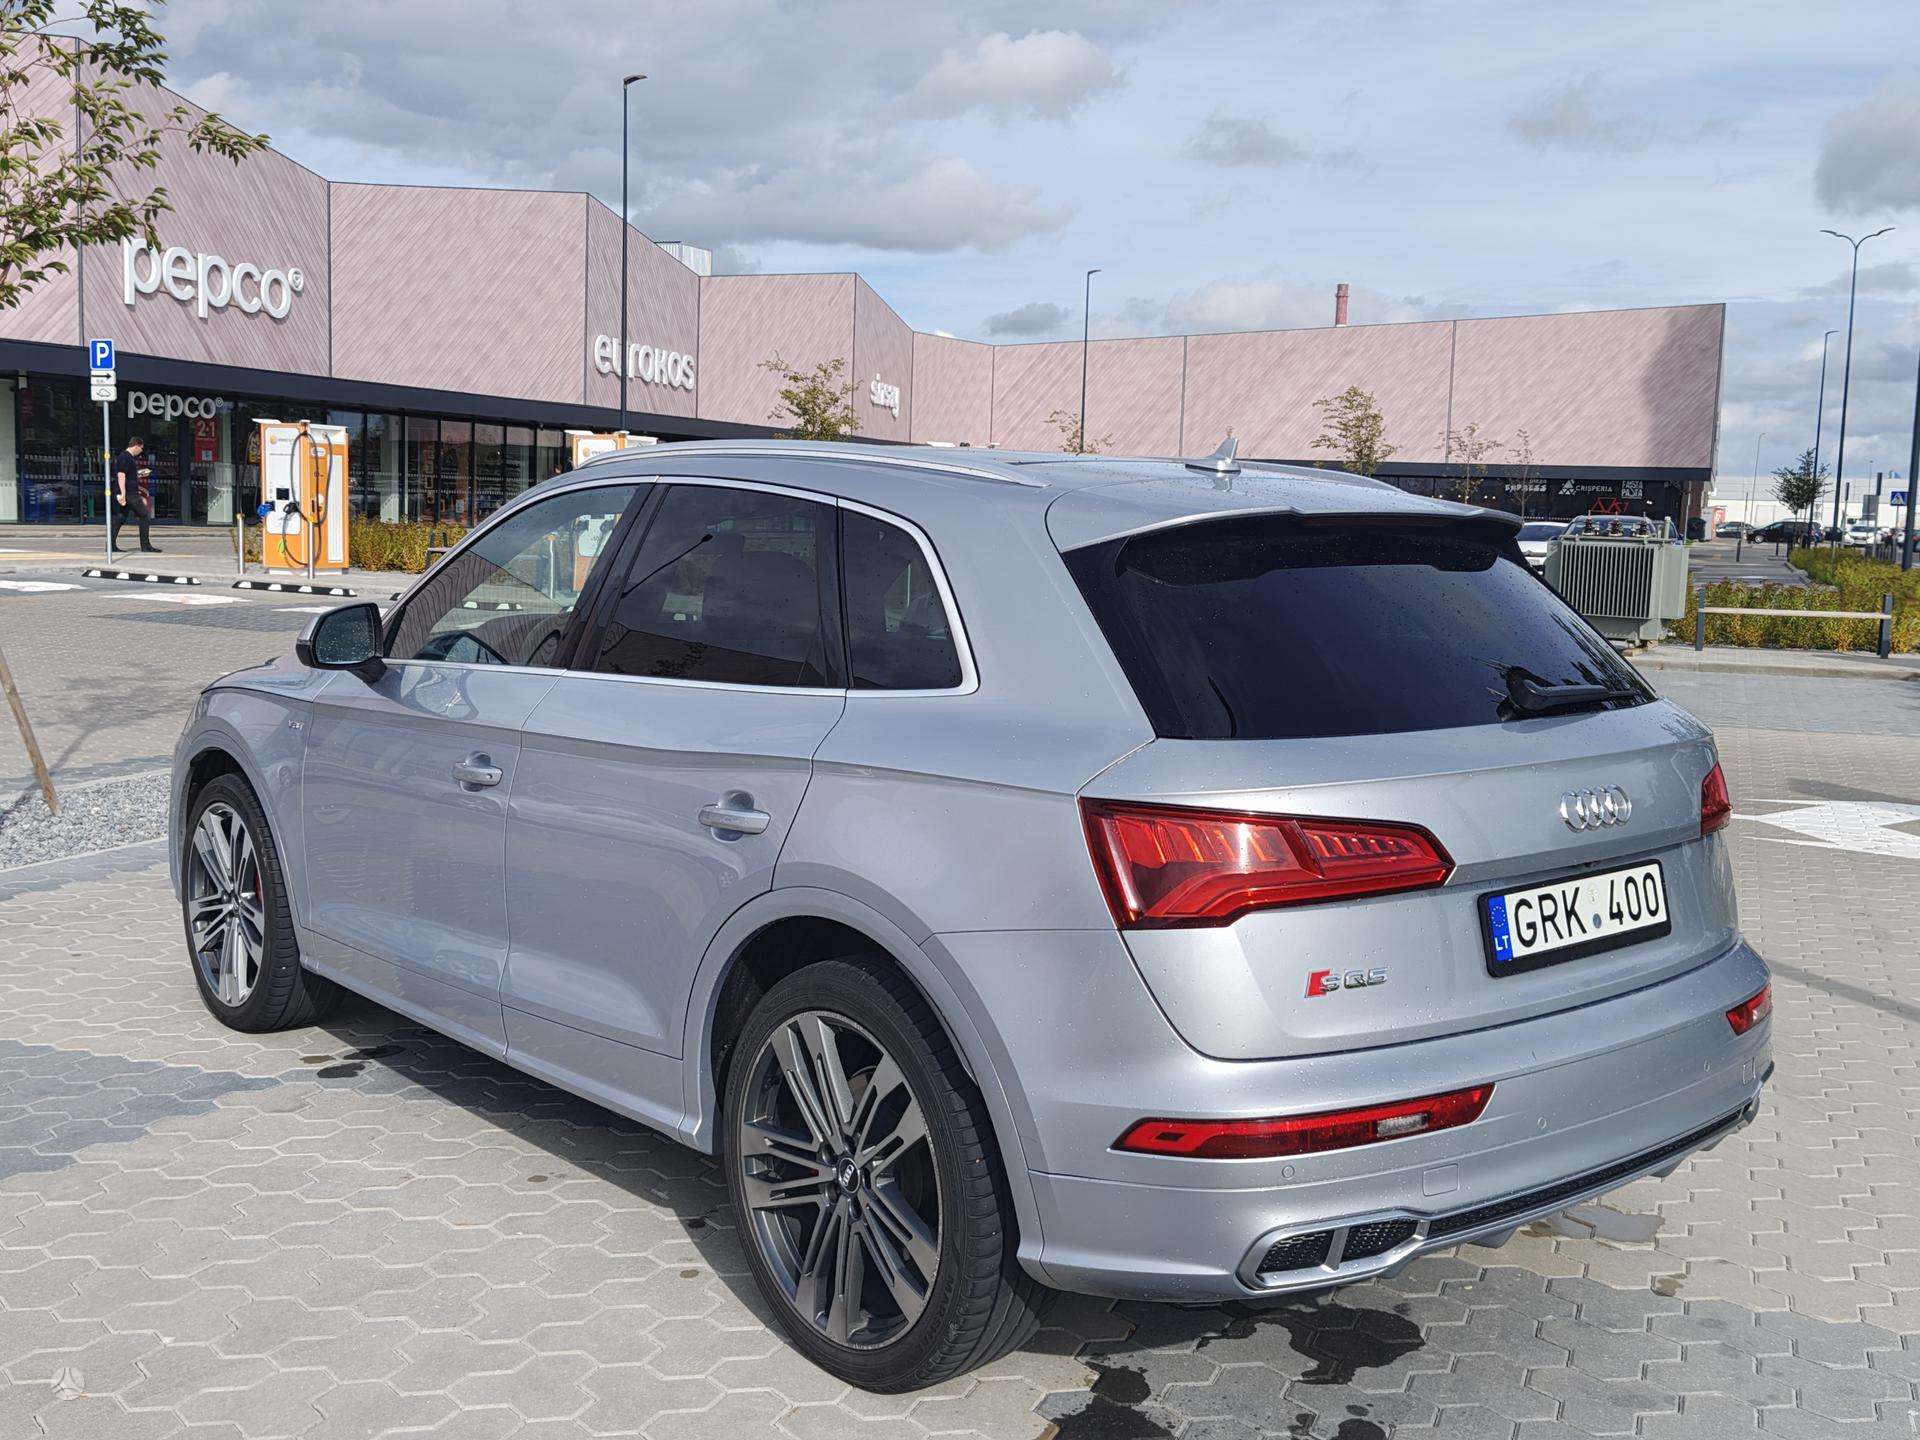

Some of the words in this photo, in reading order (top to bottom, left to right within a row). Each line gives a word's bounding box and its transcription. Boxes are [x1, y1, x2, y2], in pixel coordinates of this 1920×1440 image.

[122, 235, 291, 319] pepco
[96, 342, 109, 367] P
[127, 390, 216, 421] pepco
[1575, 484, 1612, 493] CRISPERIA
[1514, 886, 1588, 949] GRK
[1609, 872, 1660, 926] 400
[1494, 934, 1509, 951] LT
[1317, 966, 1388, 992] SQ5
